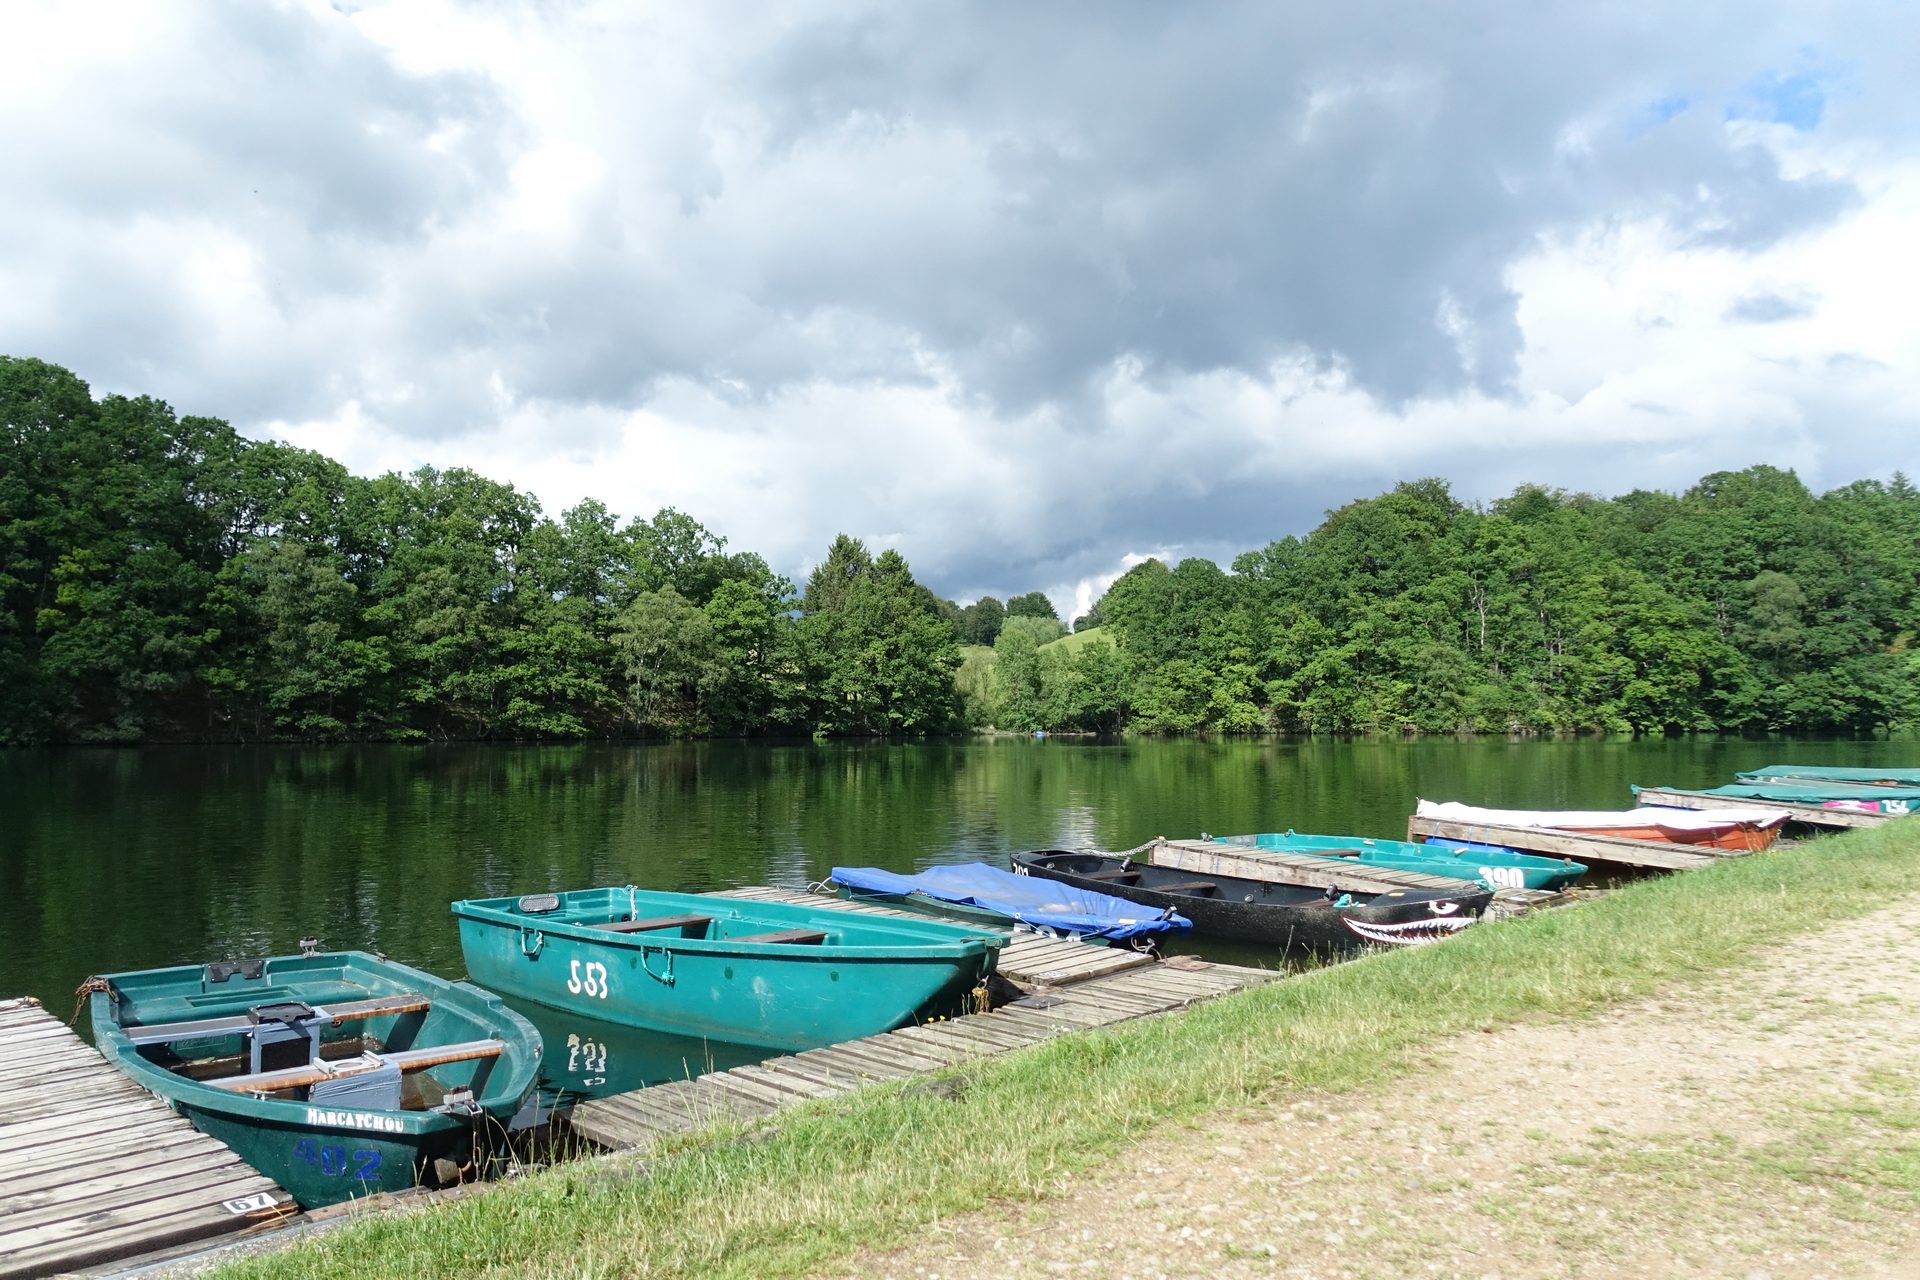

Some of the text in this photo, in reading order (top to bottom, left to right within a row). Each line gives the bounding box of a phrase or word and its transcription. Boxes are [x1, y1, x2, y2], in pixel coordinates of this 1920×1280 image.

[1478, 866, 1524, 889] 390
[567, 959, 608, 999] 553
[293, 1136, 382, 1180] 402
[229, 1194, 266, 1211] 67
